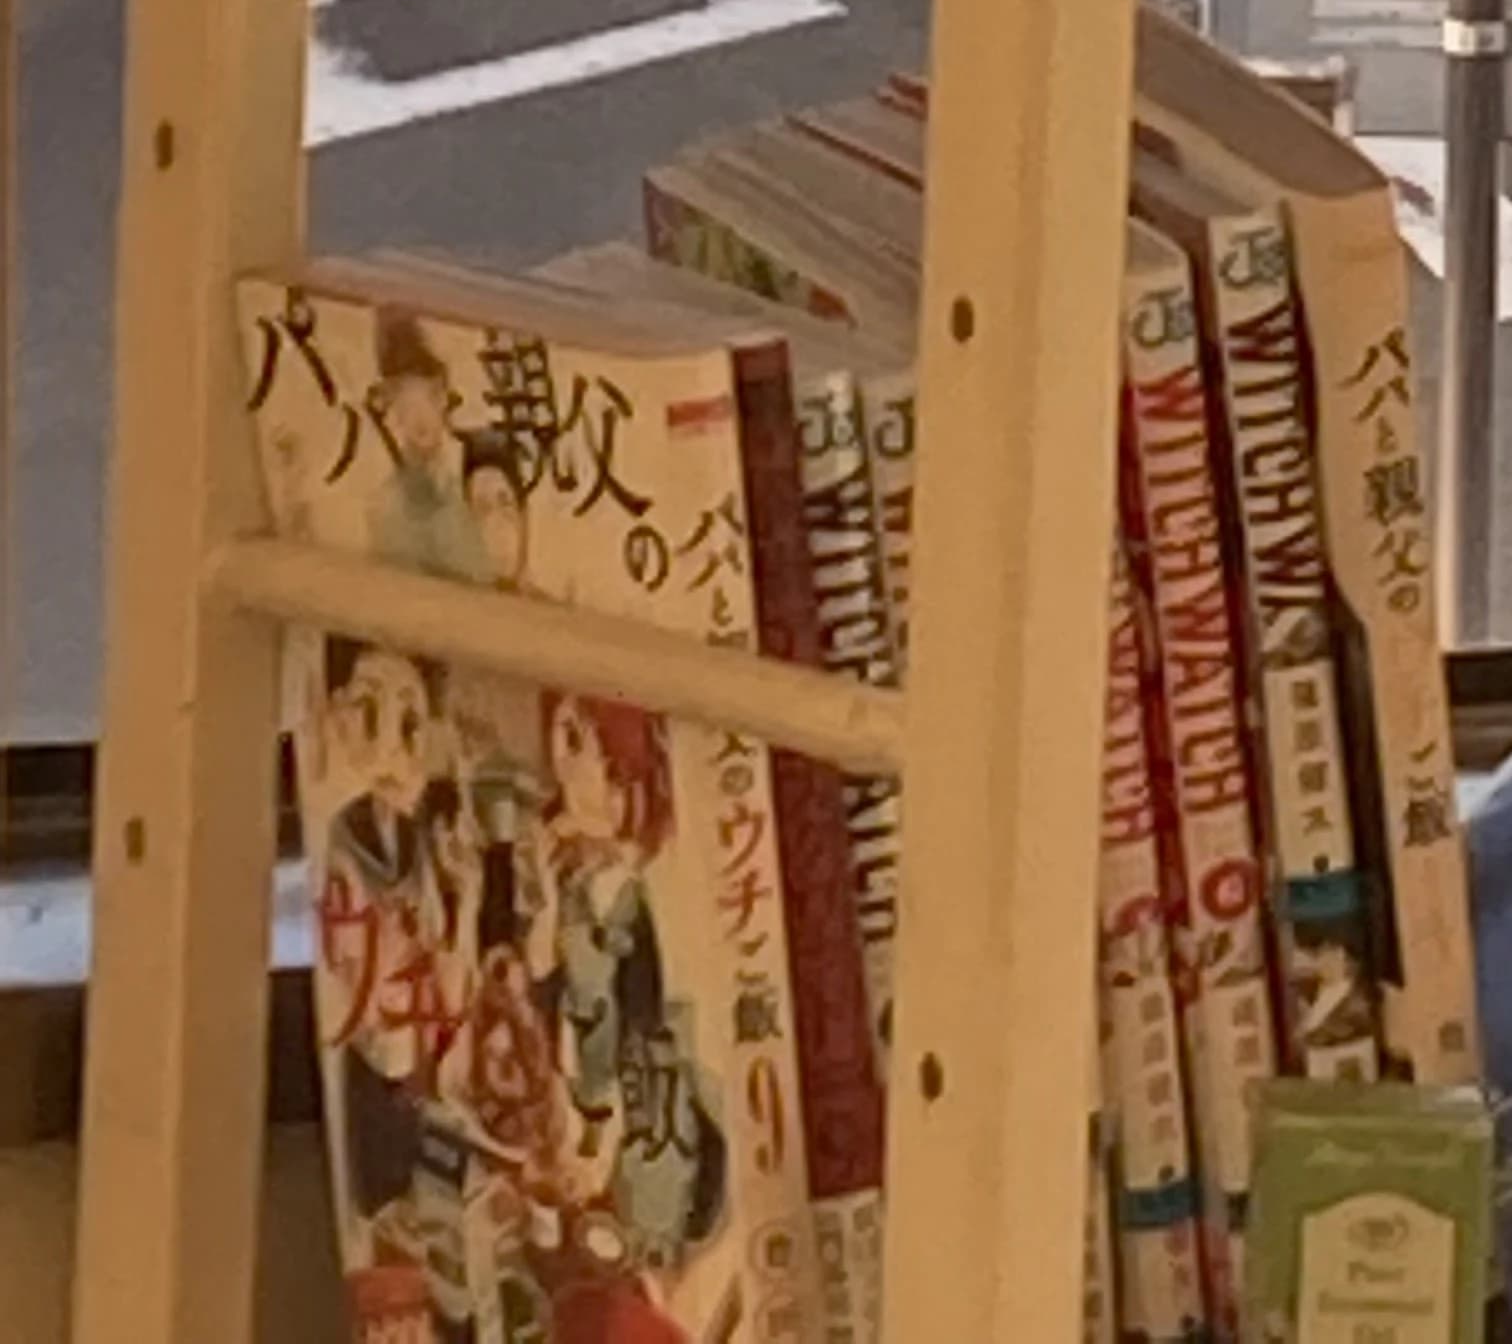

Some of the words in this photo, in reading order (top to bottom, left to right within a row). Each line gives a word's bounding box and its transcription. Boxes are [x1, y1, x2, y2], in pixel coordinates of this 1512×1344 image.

[1132, 364, 1228, 580] WITCH
[1225, 295, 1313, 528] WITCH
[1163, 582, 1247, 815] WATCH
